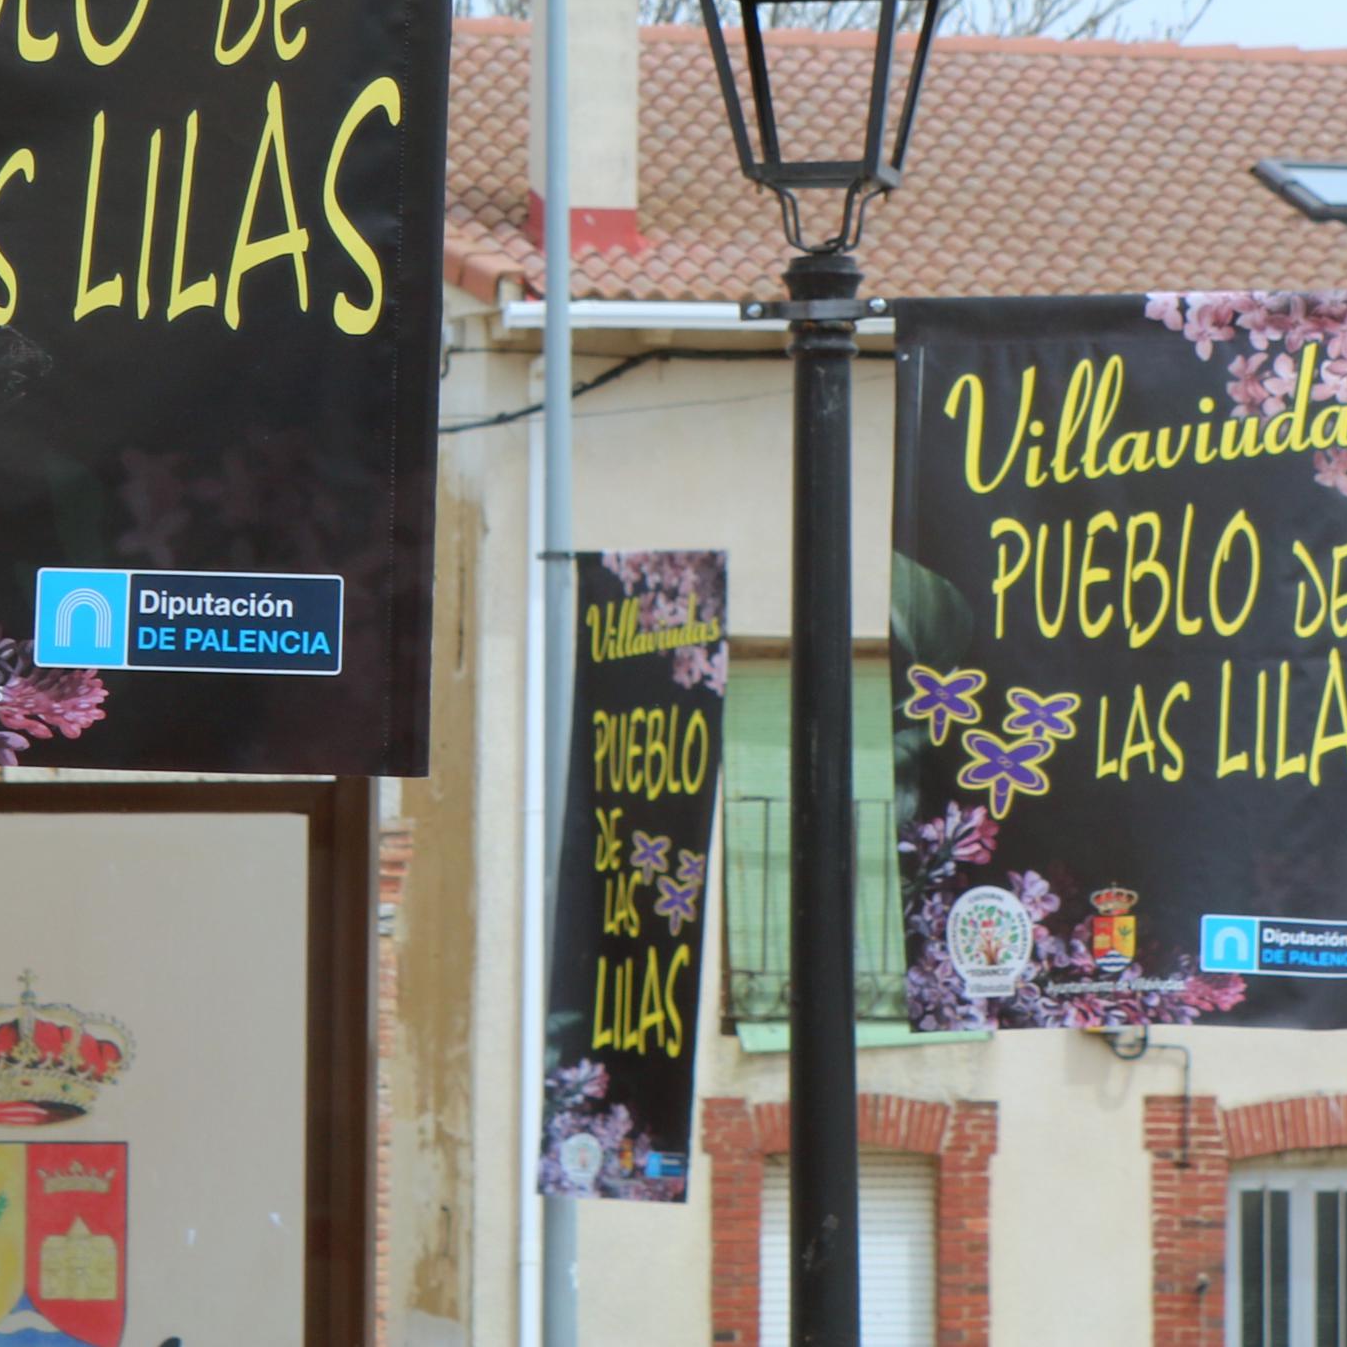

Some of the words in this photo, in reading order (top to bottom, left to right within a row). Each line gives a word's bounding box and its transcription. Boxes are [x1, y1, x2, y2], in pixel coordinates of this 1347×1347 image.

[73, 76, 402, 336] LILAS
[138, 589, 294, 620] Diputación
[991, 503, 1262, 649] PUEBLO
[137, 626, 177, 651] DE
[184, 628, 332, 655] PALENCIA
[587, 593, 721, 662] Villaviudas
[593, 705, 709, 801] PUEBLO
[1097, 681, 1192, 783] LAS
[595, 807, 623, 872] DE
[603, 871, 643, 938] LAS
[1262, 949, 1286, 964] DE
[591, 944, 690, 1058] LILAS
